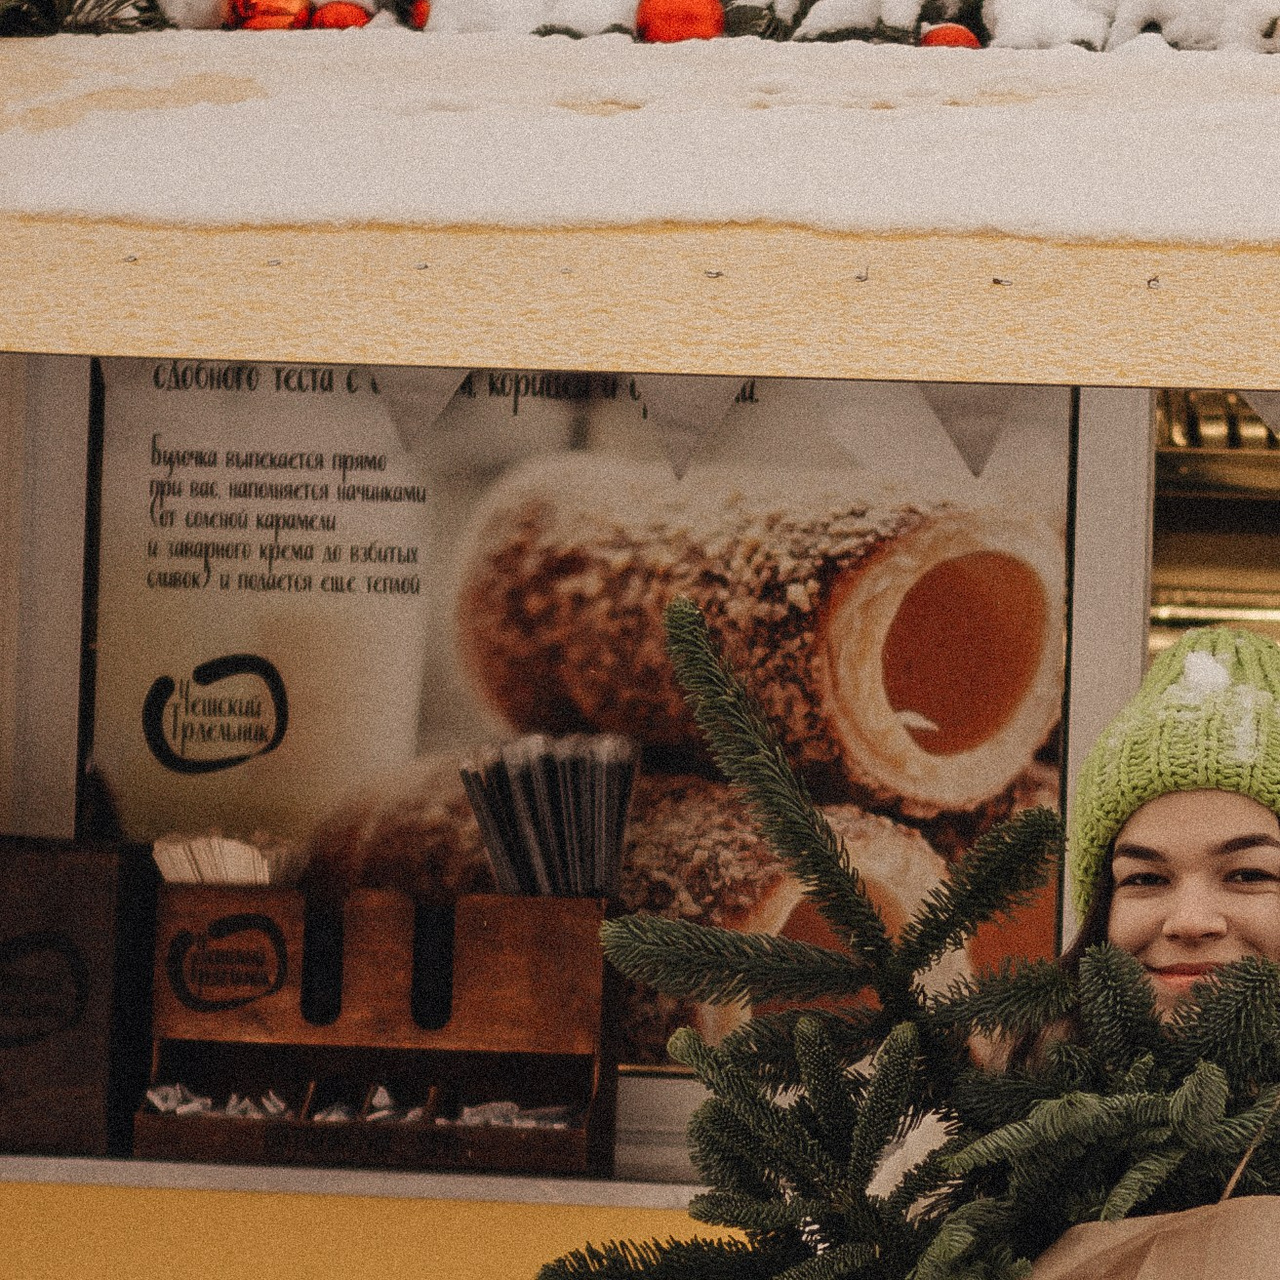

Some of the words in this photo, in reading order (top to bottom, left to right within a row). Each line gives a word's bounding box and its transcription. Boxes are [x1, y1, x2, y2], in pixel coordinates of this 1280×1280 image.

[272, 367, 334, 393] теста
[151, 433, 217, 476] Булочка
[226, 451, 323, 471] выпекается
[332, 453, 387, 482] прямо
[149, 480, 183, 507] при
[229, 481, 329, 500] наполняется
[337, 485, 427, 503] начинками
[257, 514, 336, 541] карамели
[168, 542, 251, 570] заварного
[259, 543, 314, 572] крема
[322, 546, 341, 563] до
[350, 542, 418, 563] взбитых
[238, 572, 312, 591] подается
